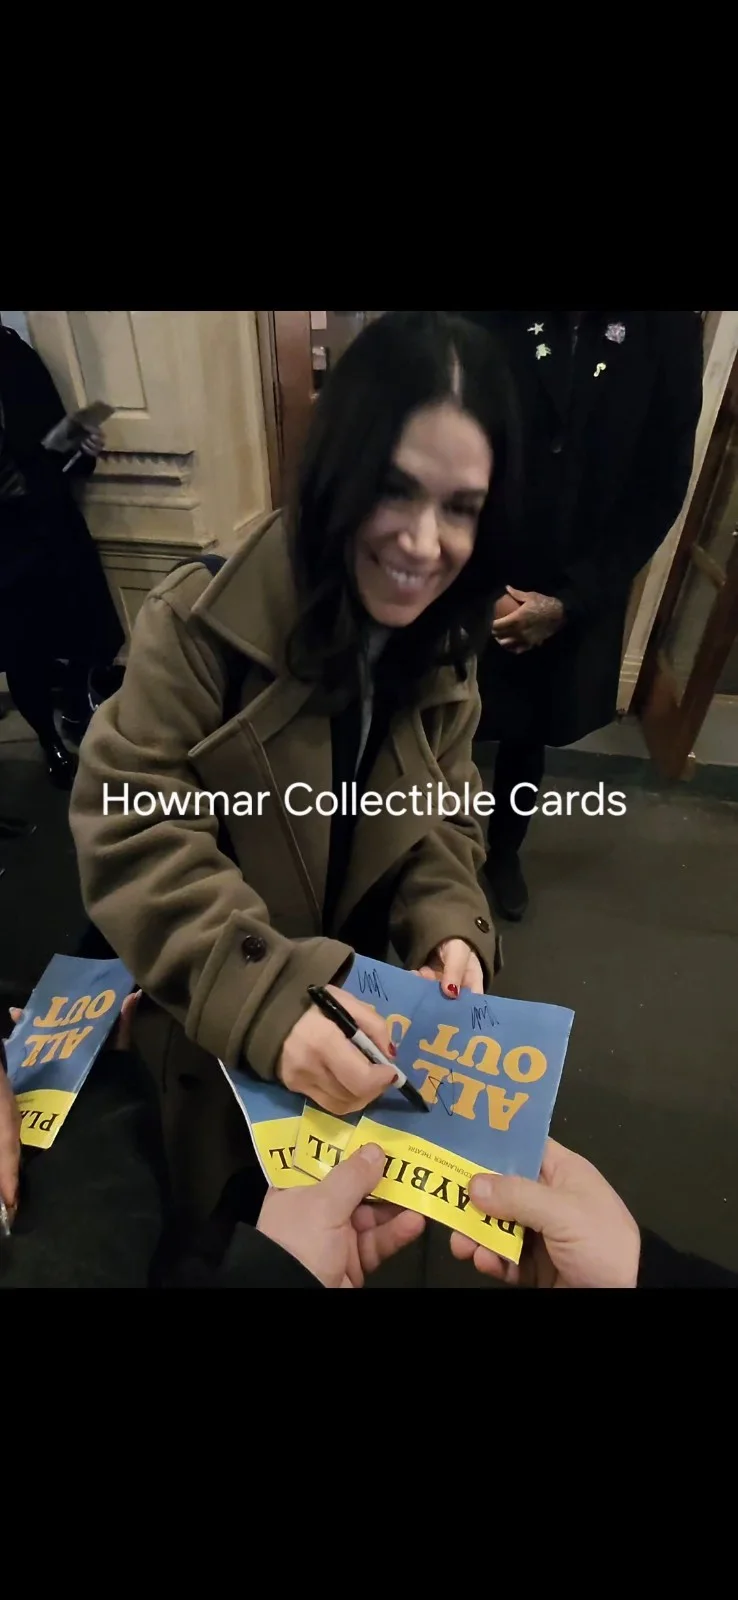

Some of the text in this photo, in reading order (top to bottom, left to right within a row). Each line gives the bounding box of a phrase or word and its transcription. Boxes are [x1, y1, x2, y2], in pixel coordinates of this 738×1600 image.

[33, 989, 116, 1029] OUT
[21, 1026, 93, 1067] ALL
[419, 1024, 548, 1083] OUT
[414, 1060, 529, 1131] ALL
[433, 1155, 474, 1180] EDERLANDER
